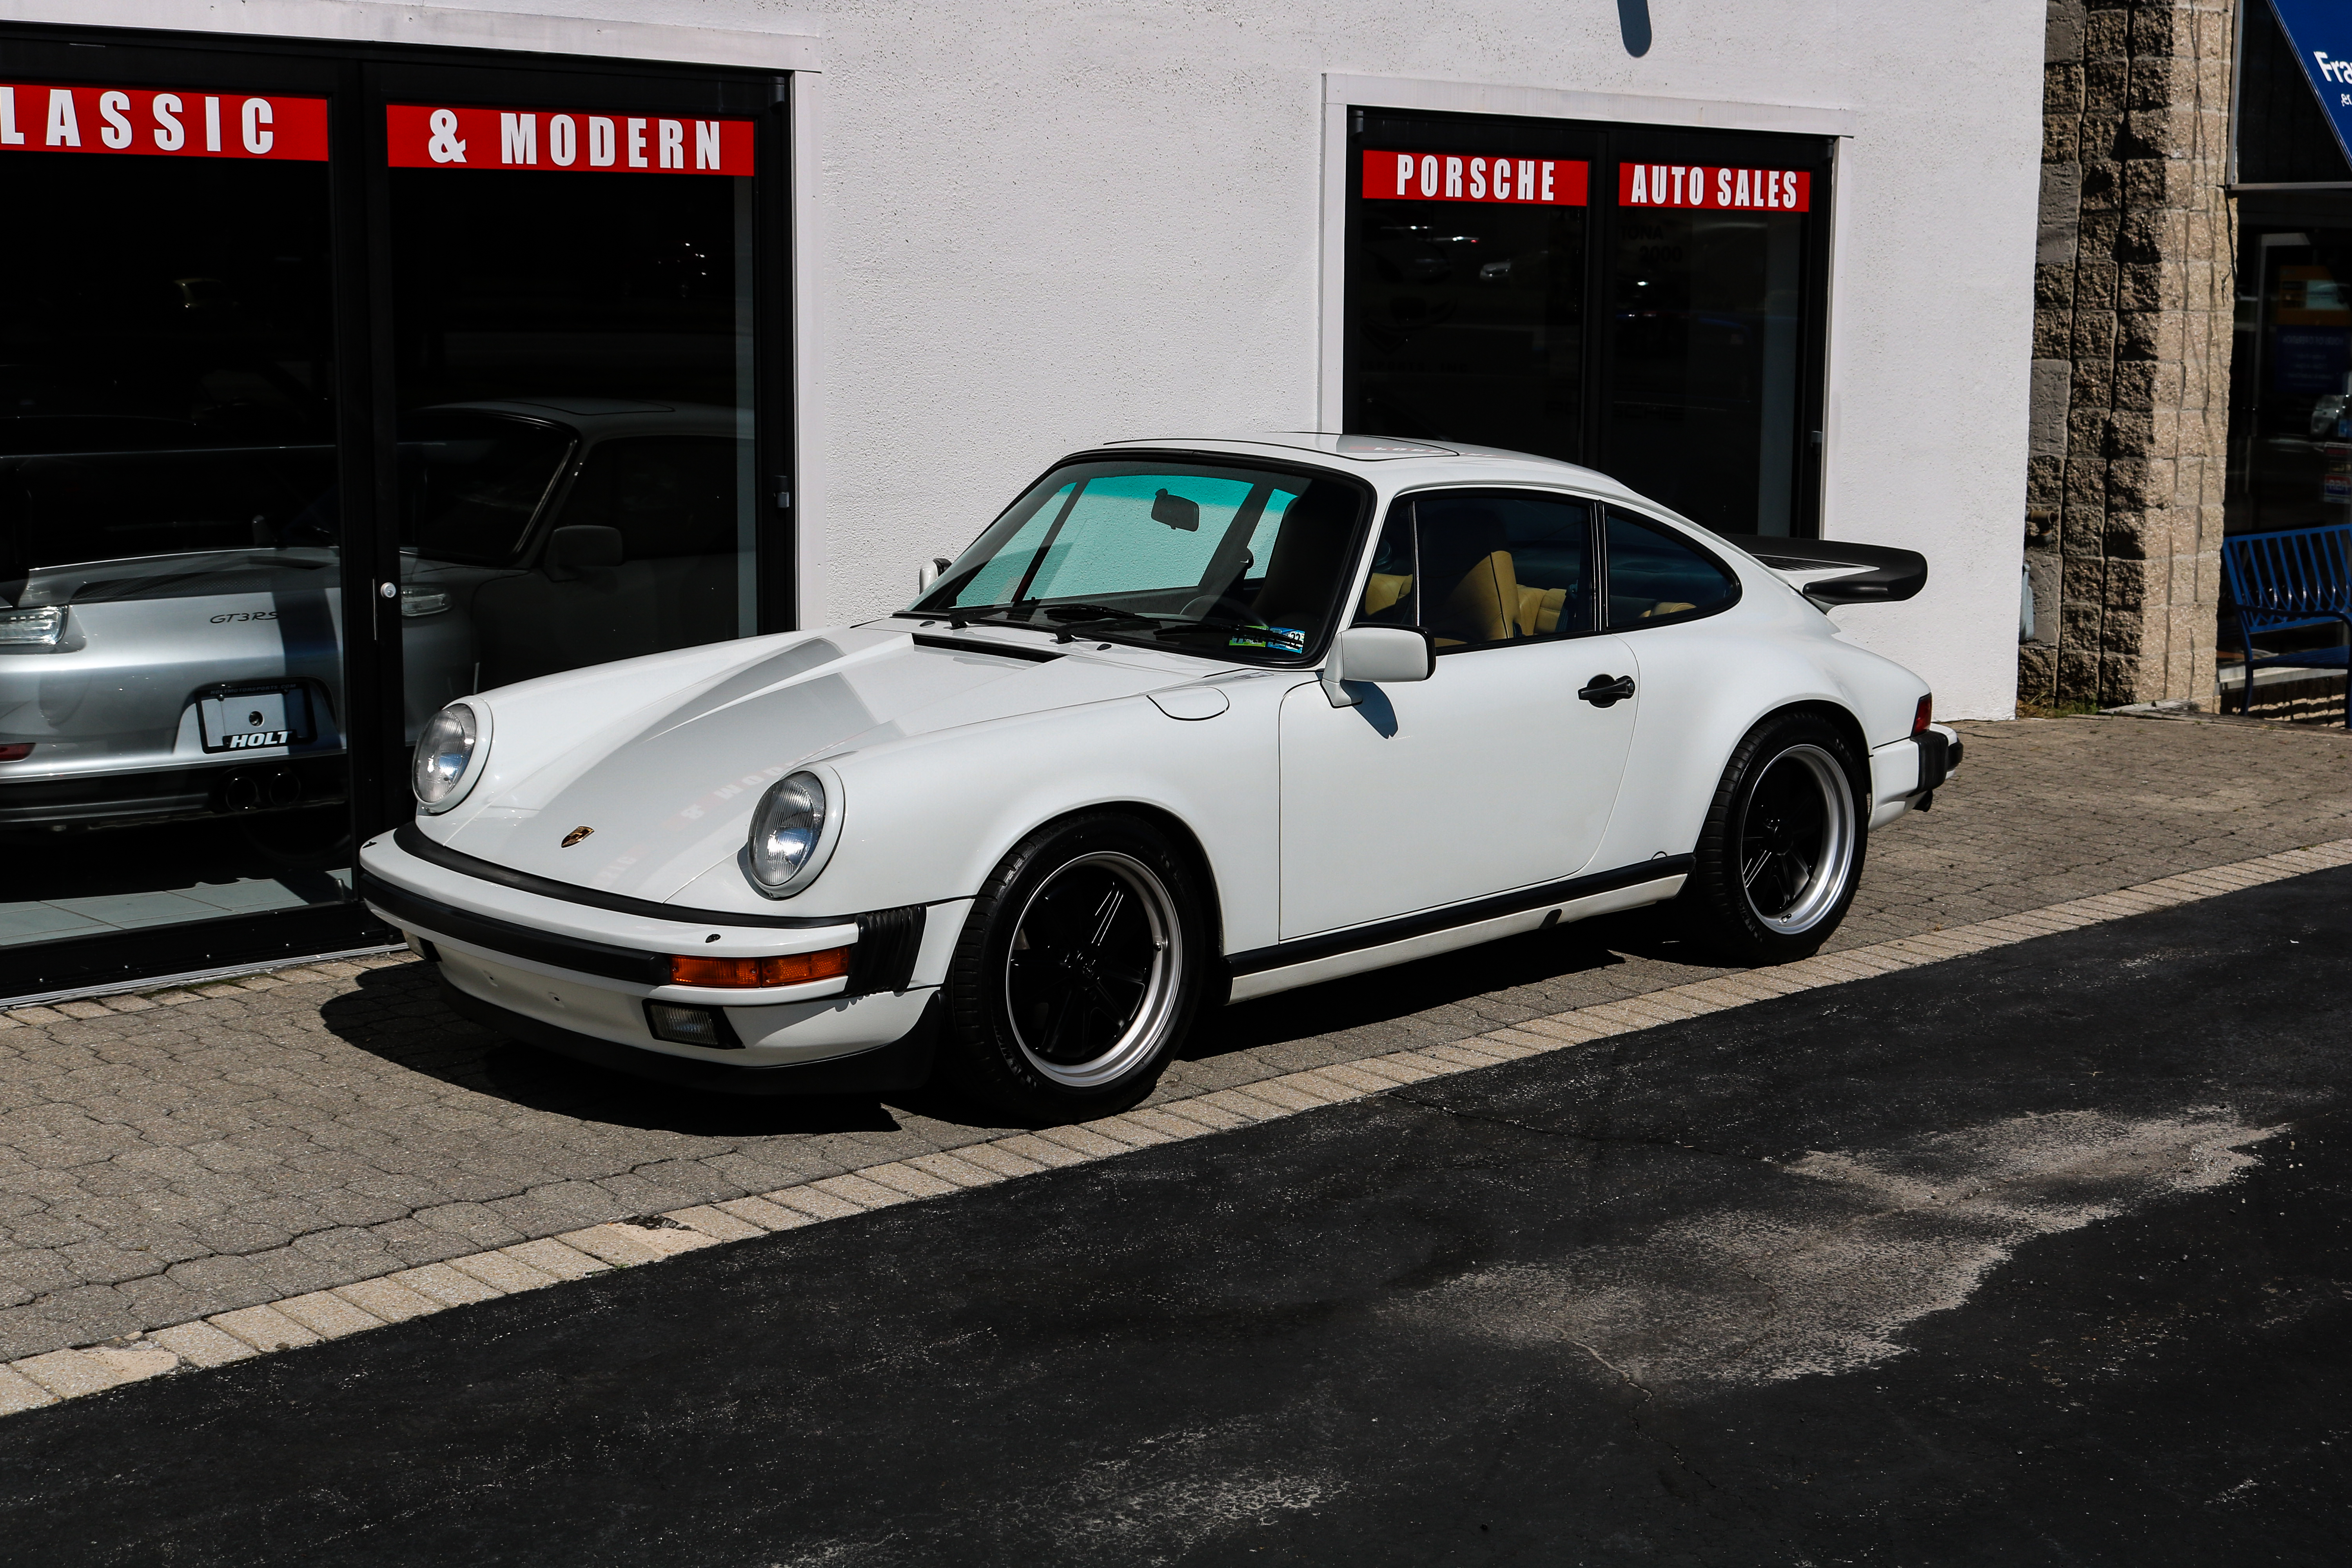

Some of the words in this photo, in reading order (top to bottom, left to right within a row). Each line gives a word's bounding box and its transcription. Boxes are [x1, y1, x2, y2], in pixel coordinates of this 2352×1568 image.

[2314, 51, 2352, 84] Fra
[0, 87, 273, 154] LASSIC
[428, 109, 467, 163] &
[501, 113, 720, 170] MODERN
[1397, 154, 1555, 201] PORSCHE
[1631, 164, 1704, 205] AUTO
[1717, 168, 1797, 209] SALES
[210, 612, 279, 623] GT3RS
[210, 684, 296, 695] HOLTMOTORSPORTS.COM
[229, 731, 292, 748] HOLT
